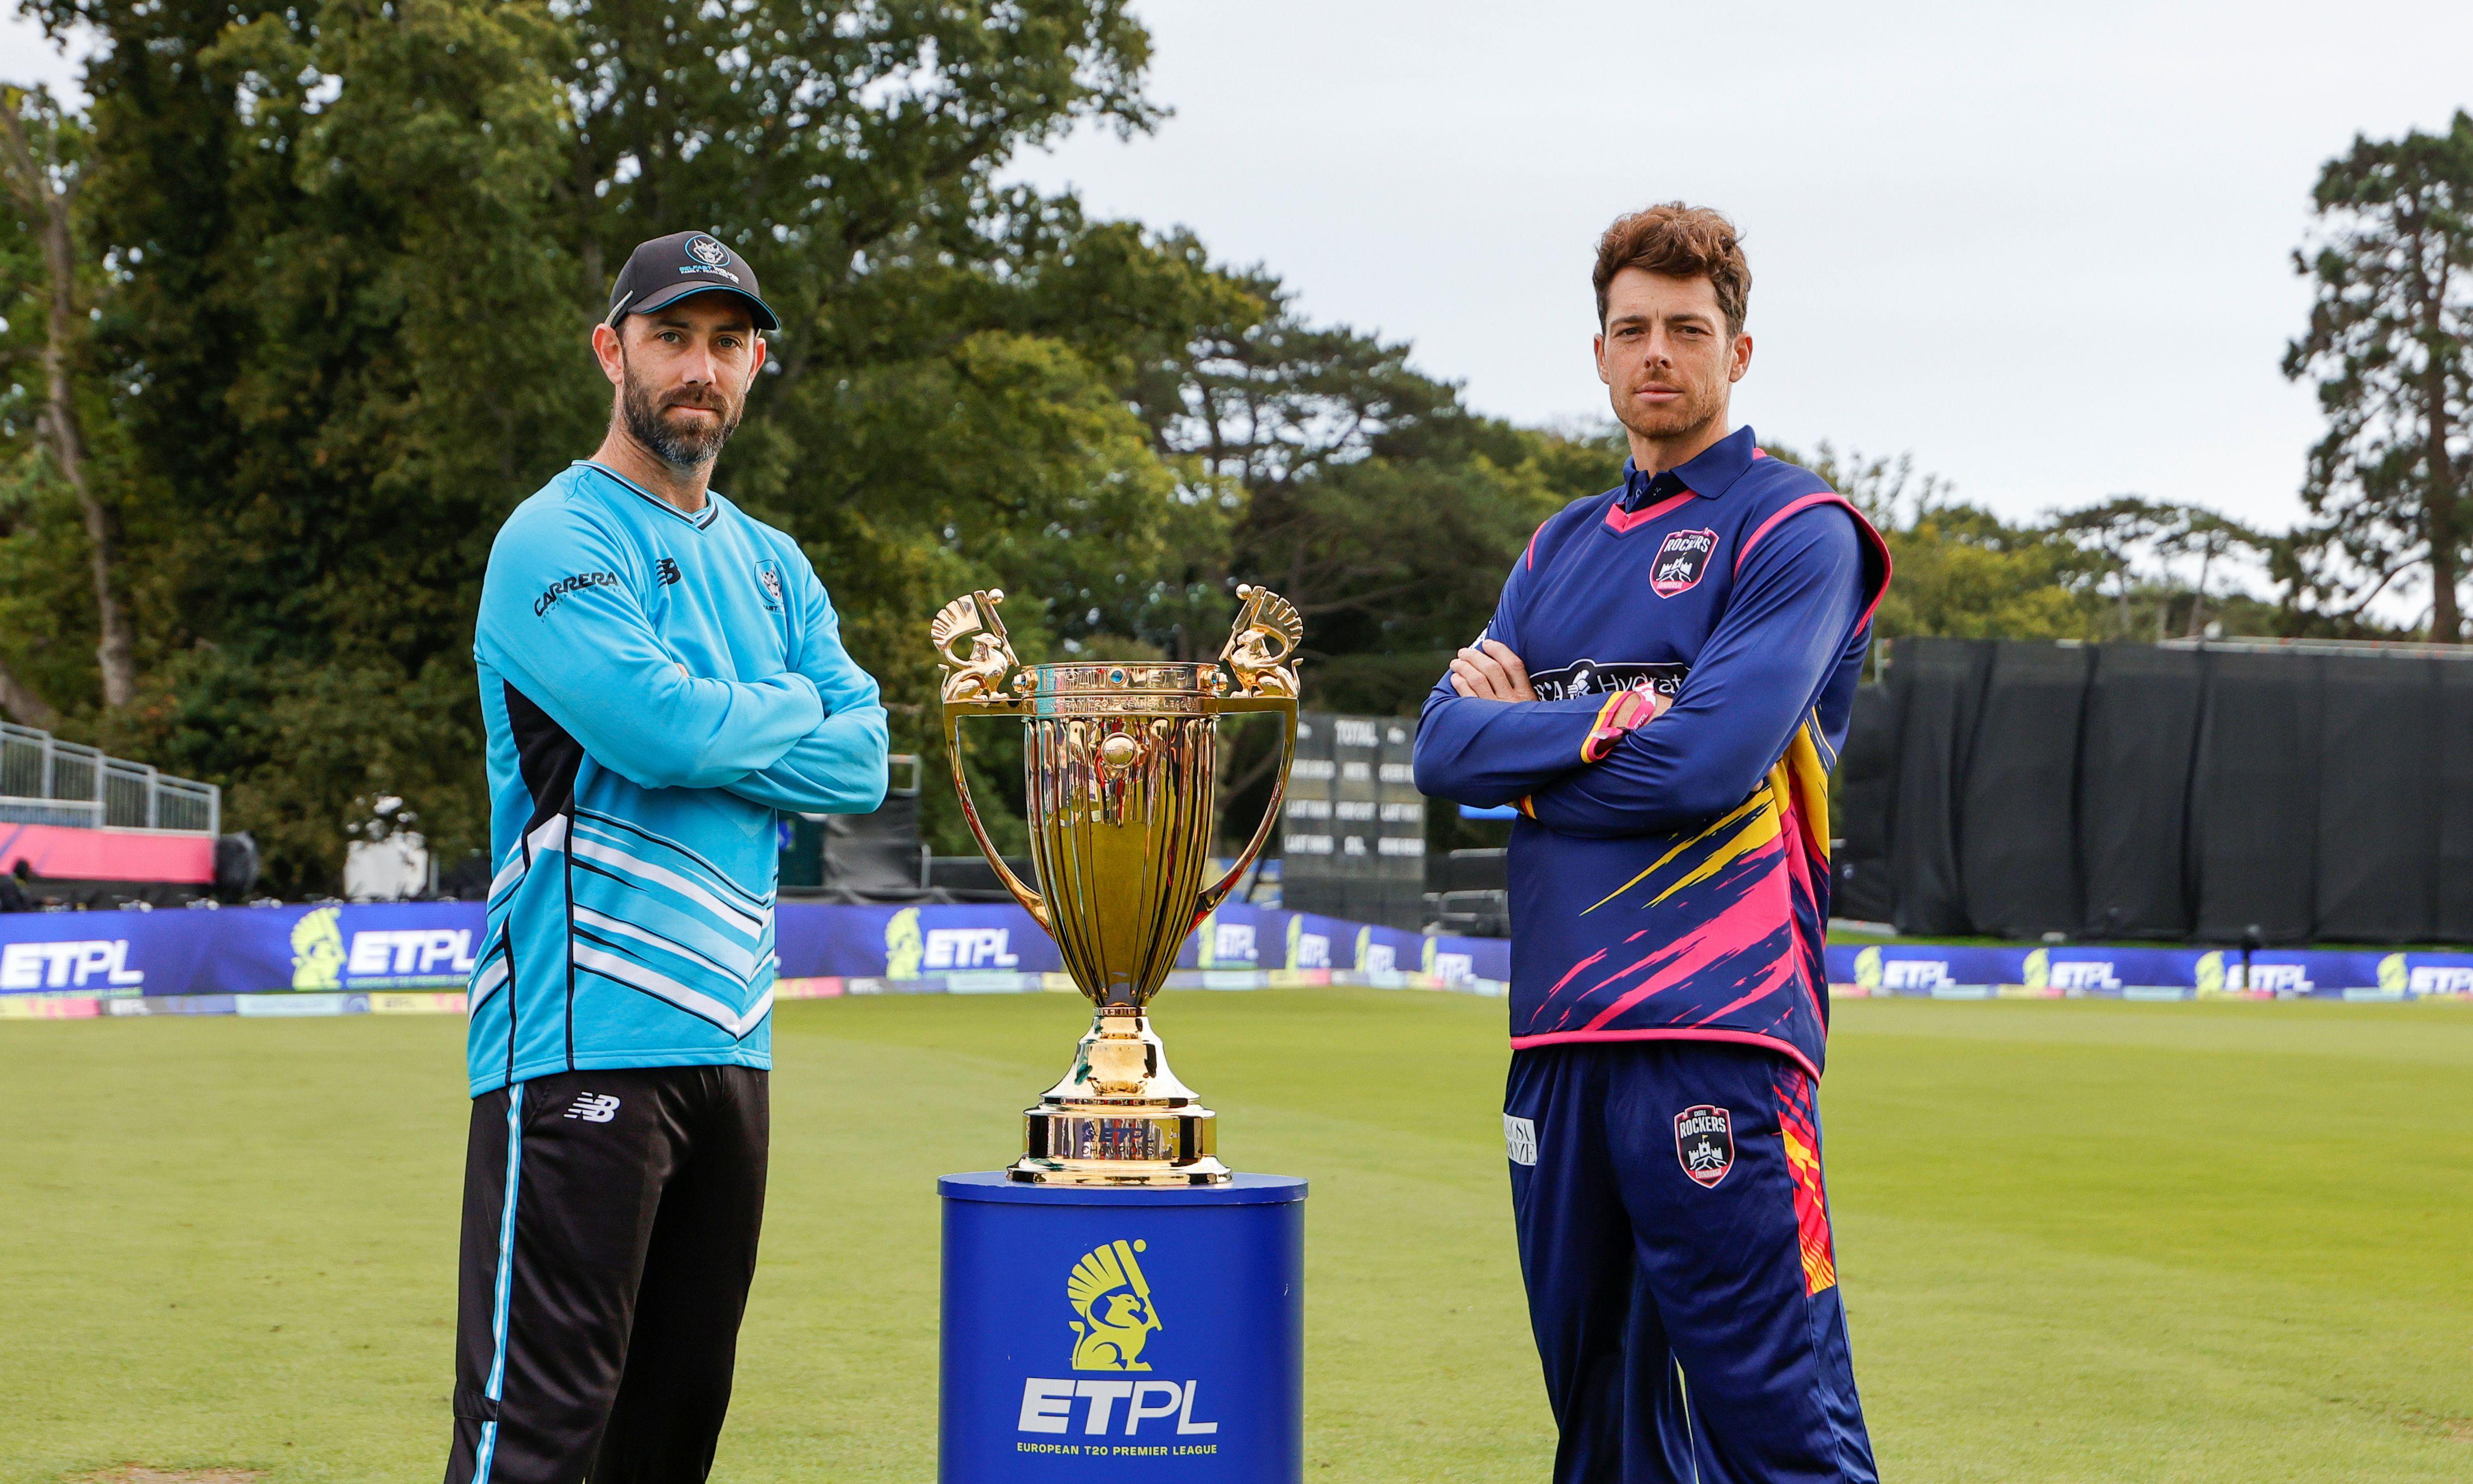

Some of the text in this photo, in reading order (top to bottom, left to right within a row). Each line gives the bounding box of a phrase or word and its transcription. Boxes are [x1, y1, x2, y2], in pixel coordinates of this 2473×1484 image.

[534, 572, 618, 616] CARRERA
[1335, 720, 1379, 747] TOTAL
[347, 928, 476, 974] ETPL
[923, 928, 1019, 968] ETPL
[0, 939, 145, 990] ETPL
[1882, 960, 1956, 989] ETPL
[2050, 962, 2121, 989] ETPL
[2224, 964, 2314, 992] ETPL
[2410, 966, 2473, 993] ETP
[1680, 1117, 1726, 1138] ROCKERS
[1082, 1146, 1154, 1155] CHAMPIONS
[1695, 1168, 1722, 1178] EDINBURGH
[1017, 1377, 1218, 1435] ETPL
[1017, 1442, 1217, 1456] EUROPEAN T20 PREMIER LEAGUE
